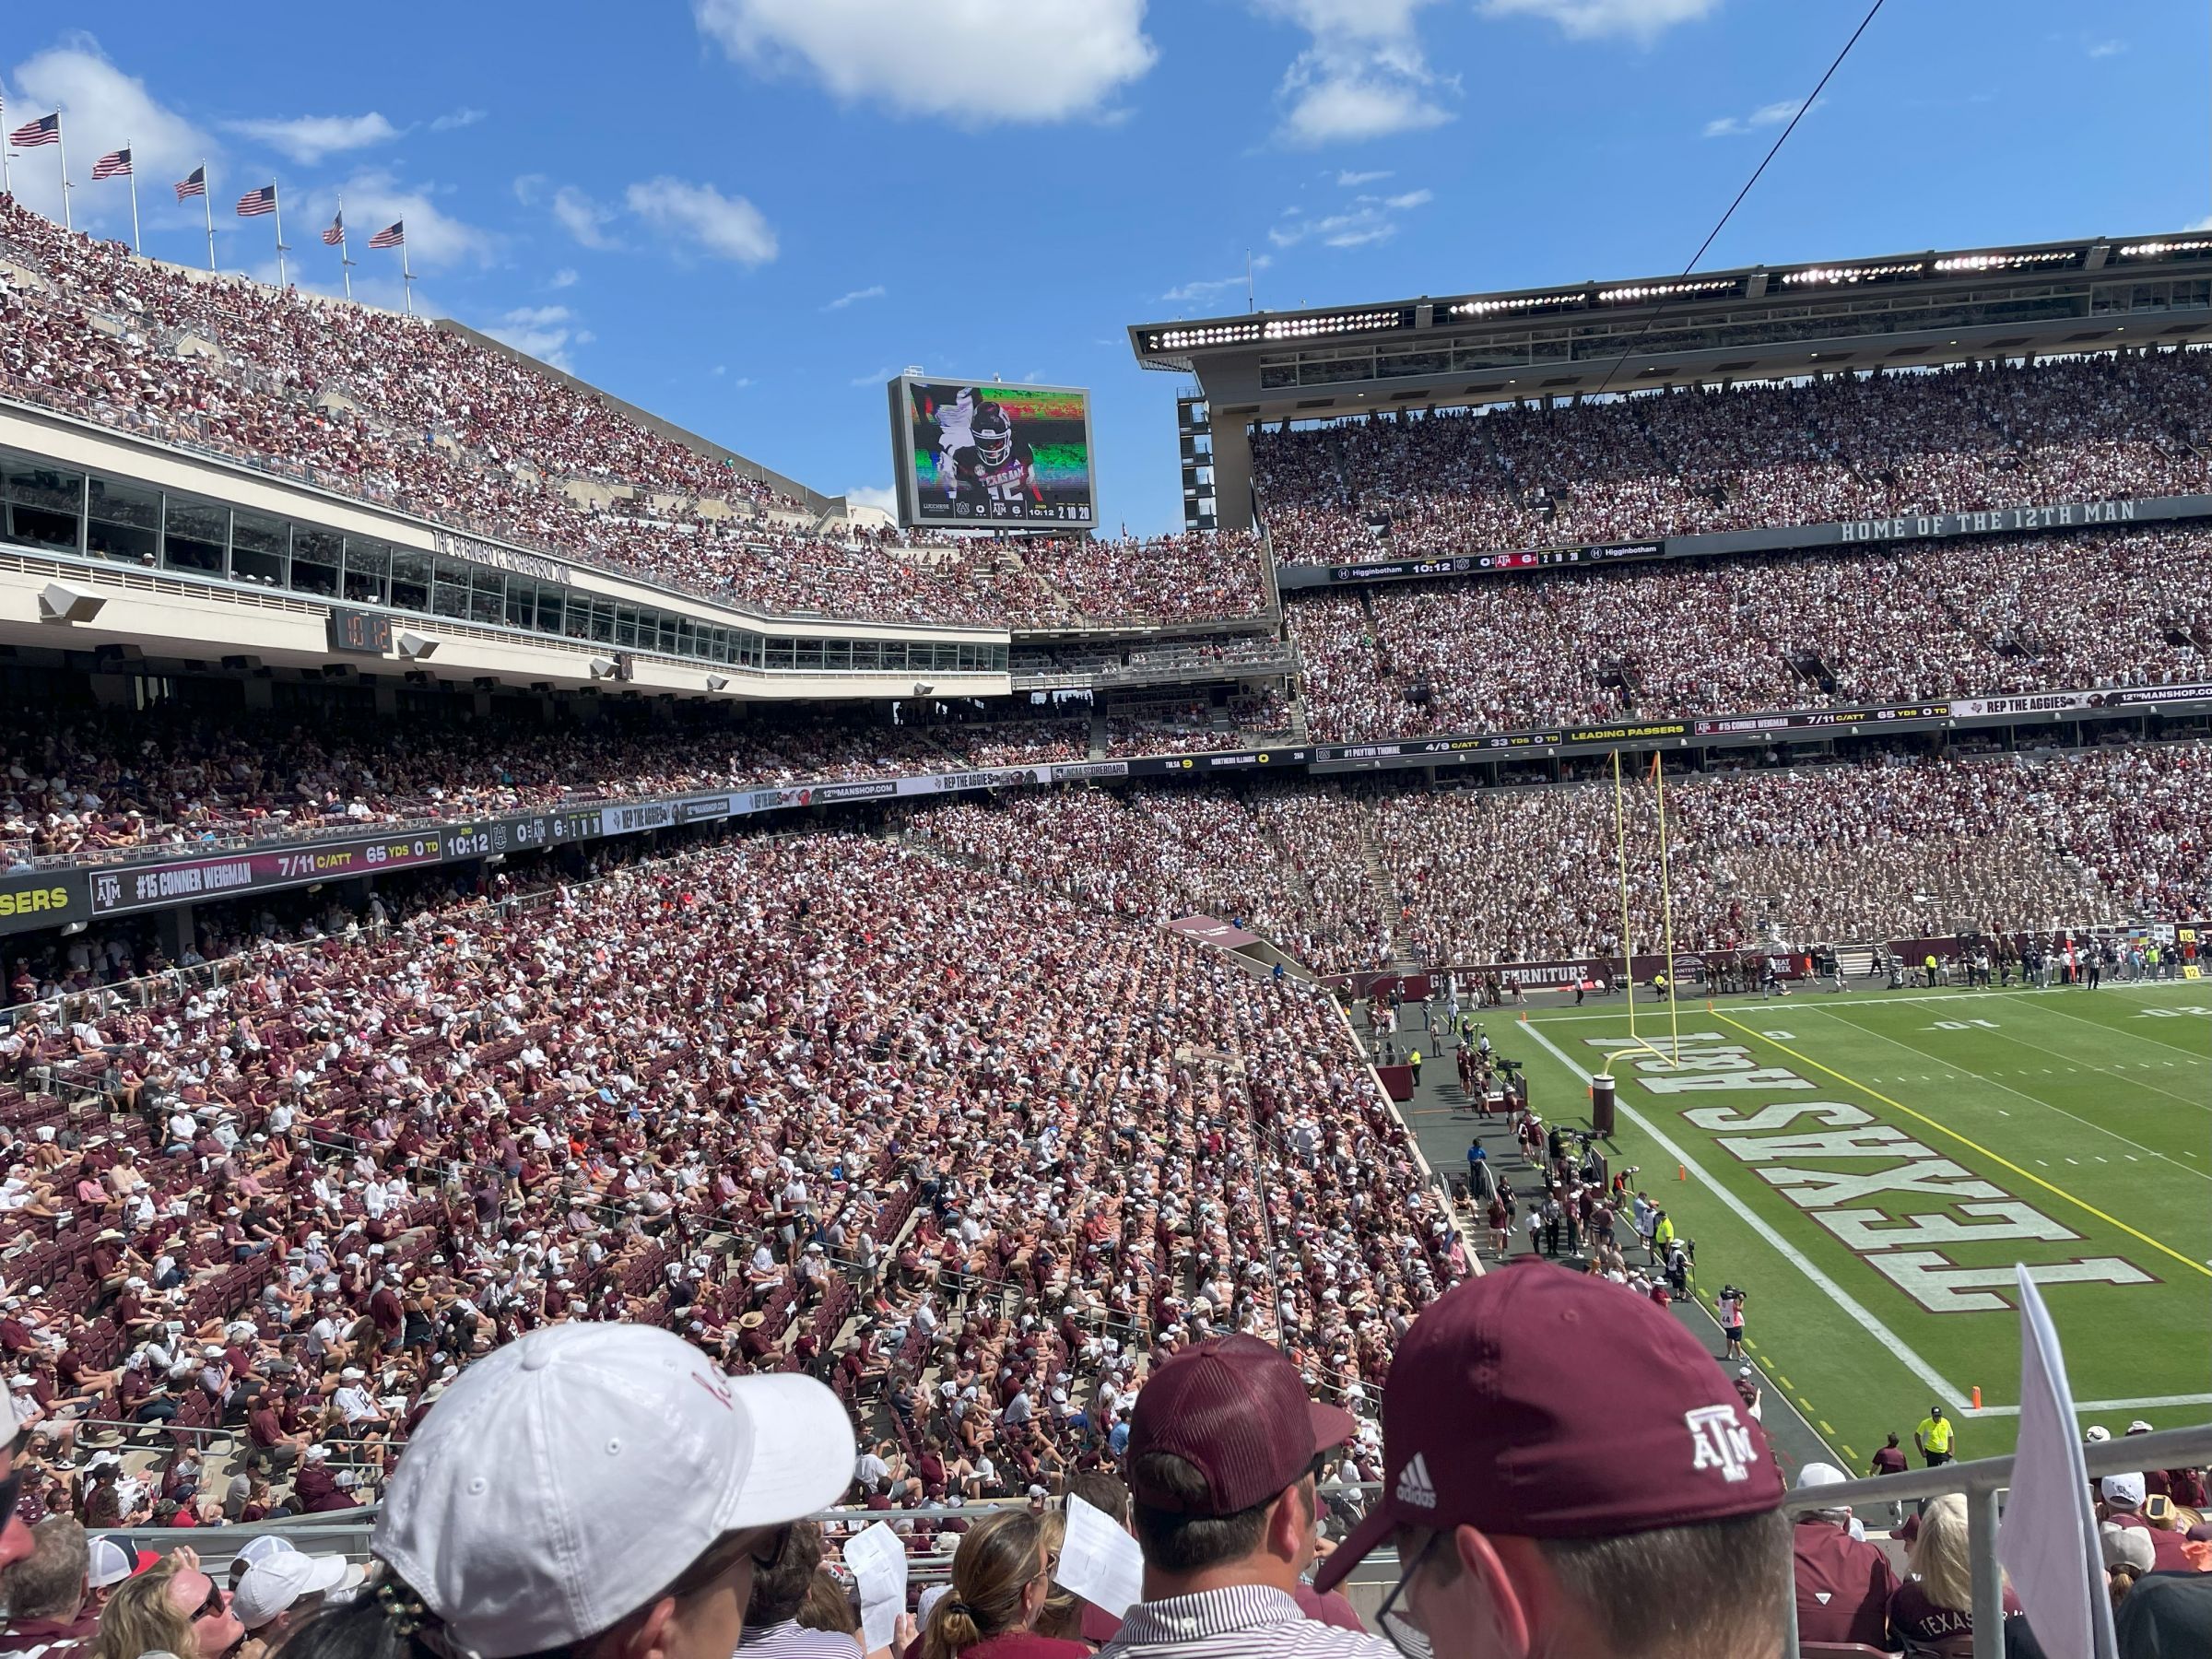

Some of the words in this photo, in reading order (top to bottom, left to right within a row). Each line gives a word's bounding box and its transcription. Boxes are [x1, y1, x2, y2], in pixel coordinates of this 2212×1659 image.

[975, 504, 985, 514] 0
[1012, 506, 1021, 514] 6
[1058, 506, 1065, 519] 2
[1067, 506, 1077, 520] 10
[1078, 506, 1089, 520] 20
[1841, 519, 1906, 541] HOME
[1918, 515, 1944, 535] OF
[1957, 511, 2003, 533] THE
[2014, 506, 2072, 528] 12TH
[2084, 500, 2136, 523] MAN
[433, 530, 451, 554] THE
[453, 535, 494, 565] BERNARD
[506, 551, 553, 581] RICHARDSON
[1543, 555, 1548, 563] 2
[1555, 554, 1563, 562] 10
[1570, 552, 1578, 560] 20
[1605, 546, 1657, 556] Higginbotham
[1479, 558, 1490, 567] 0
[1521, 555, 1532, 563] 6
[1352, 566, 1402, 576] Higginbotham
[1413, 562, 1451, 573] 10:12
[1987, 700, 2007, 713] REP
[2009, 699, 2029, 712] THE
[2030, 695, 2067, 711] AGGIES
[1718, 721, 1730, 731] #15
[1731, 719, 1757, 731] CONNER
[1757, 717, 1789, 729] WEIGMAN
[1806, 714, 1835, 725] 7/11
[1836, 713, 1865, 722] C/ATT
[1877, 710, 1895, 720] 65
[1897, 710, 1917, 718] YDS
[1922, 707, 1933, 716] 0
[1934, 707, 1947, 715] TD
[1571, 729, 1626, 740] LEADING
[1628, 725, 1685, 736] PASSERS
[1344, 748, 1352, 758] #1
[1353, 747, 1377, 757] PAYTON
[1377, 746, 1401, 755] THORNE
[1426, 742, 1450, 751] 4/9
[1490, 738, 1509, 747] 33
[1534, 735, 1544, 744] 0
[1165, 760, 1181, 769] TULSA
[1182, 759, 1193, 769] 9
[1211, 757, 1236, 766] NORTHERN
[1236, 755, 1256, 764] ILLINOIS
[1258, 753, 1269, 763] 0
[1066, 767, 1083, 777] NCAA
[1084, 764, 1125, 775] SCOREBOARD
[944, 776, 956, 789] REP
[956, 774, 969, 788] THE
[969, 773, 994, 786] AGGIES
[823, 783, 893, 798] 12THMANSHOP.COM
[633, 808, 644, 828] THE
[461, 827, 473, 836] 2ND
[516, 824, 527, 842] 0
[554, 819, 563, 837] 6
[448, 833, 488, 856] 10:12
[136, 874, 158, 900] #15
[159, 868, 201, 895] CONNER
[203, 862, 253, 889] WEIGMAN
[278, 854, 315, 877] 7/11
[316, 853, 351, 869] C/ATT
[366, 845, 386, 864] 65
[388, 844, 409, 858] YDS
[414, 841, 424, 856] 0
[425, 841, 439, 853] TD
[1660, 967, 1695, 975] ENANTED
[2186, 969, 2198, 977] 12
[1933, 1019, 2001, 1030] 10
[1678, 1099, 2165, 1313] TEXAS
[1396, 1484, 1437, 1509] adidas
